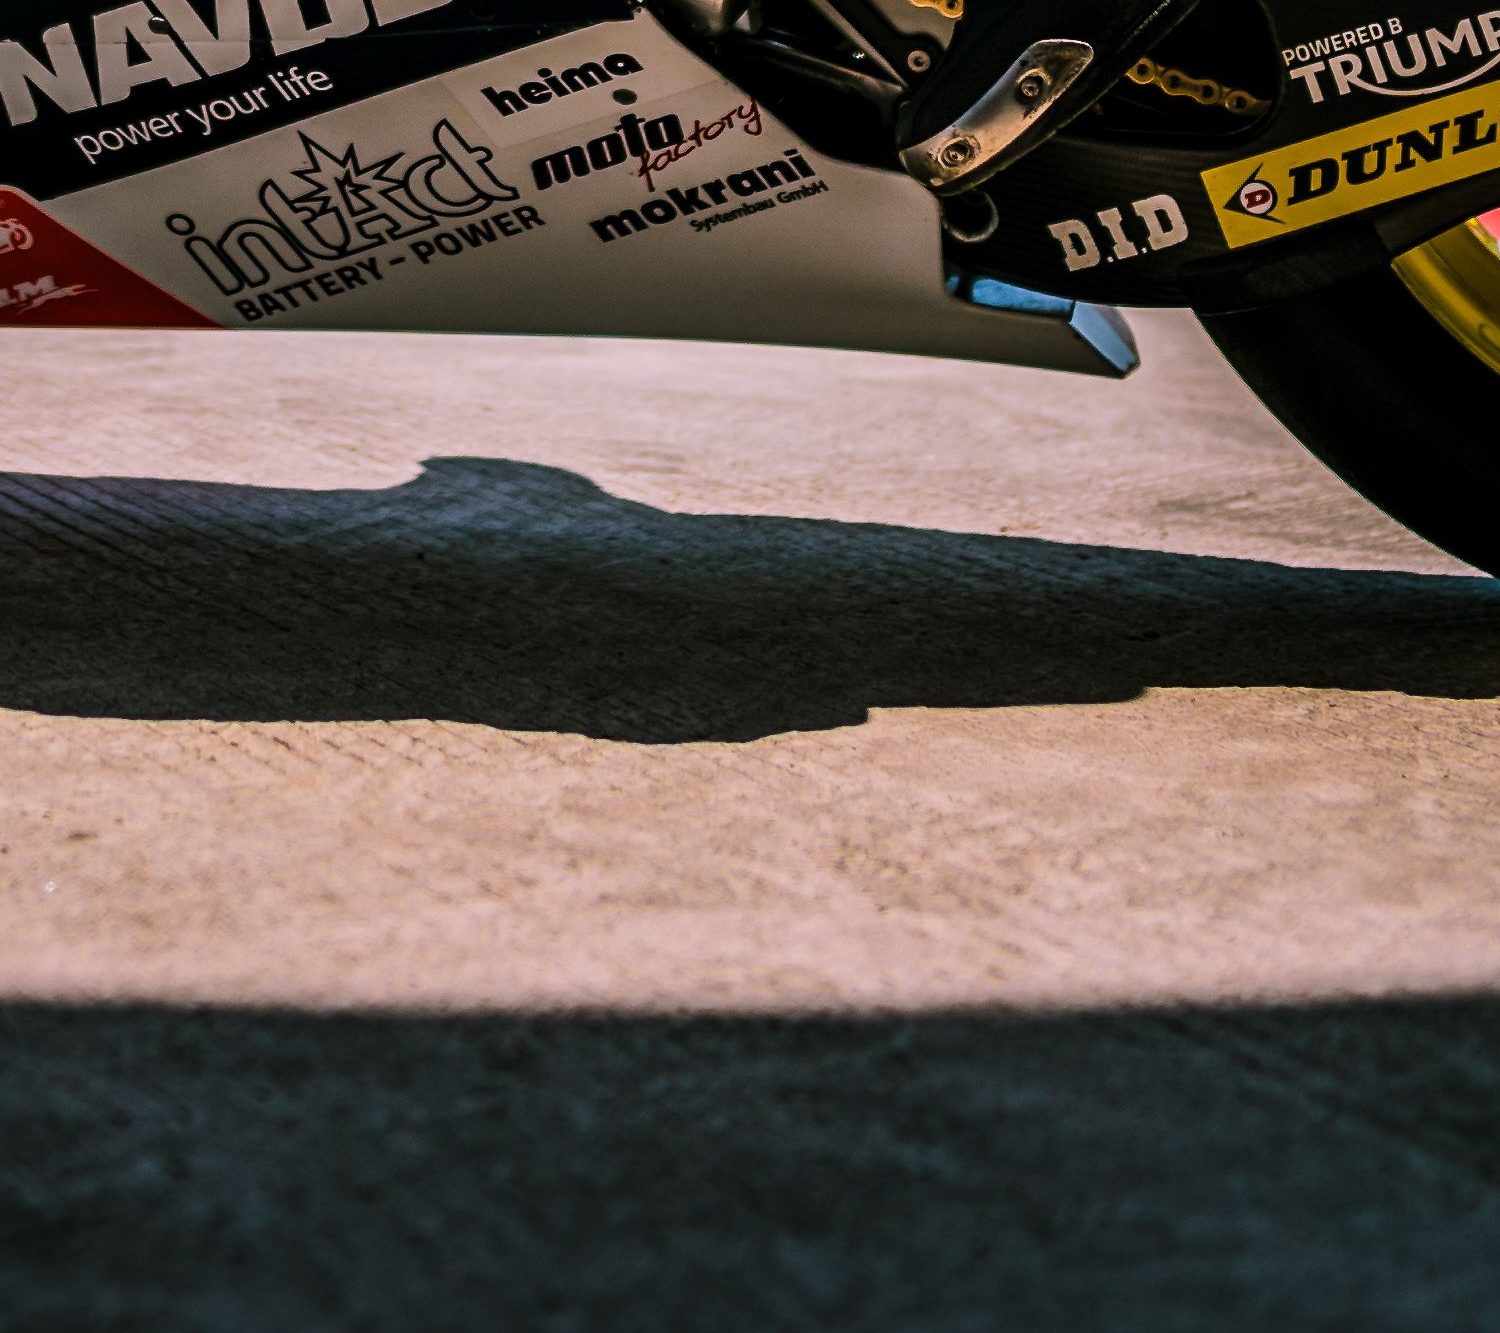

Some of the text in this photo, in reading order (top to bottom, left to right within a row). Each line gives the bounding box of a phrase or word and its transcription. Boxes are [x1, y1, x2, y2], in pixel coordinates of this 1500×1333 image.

[481, 53, 644, 117] heima
[1282, 23, 1384, 67] POWERED
[74, 66, 333, 163] power your life
[531, 98, 763, 193] moto factory
[590, 148, 816, 244] mokrani
[690, 179, 830, 233] Systembau GmbH
[1049, 194, 1190, 272] D.I.D
[235, 256, 384, 322] BATTERY
[410, 205, 546, 265] POWER
